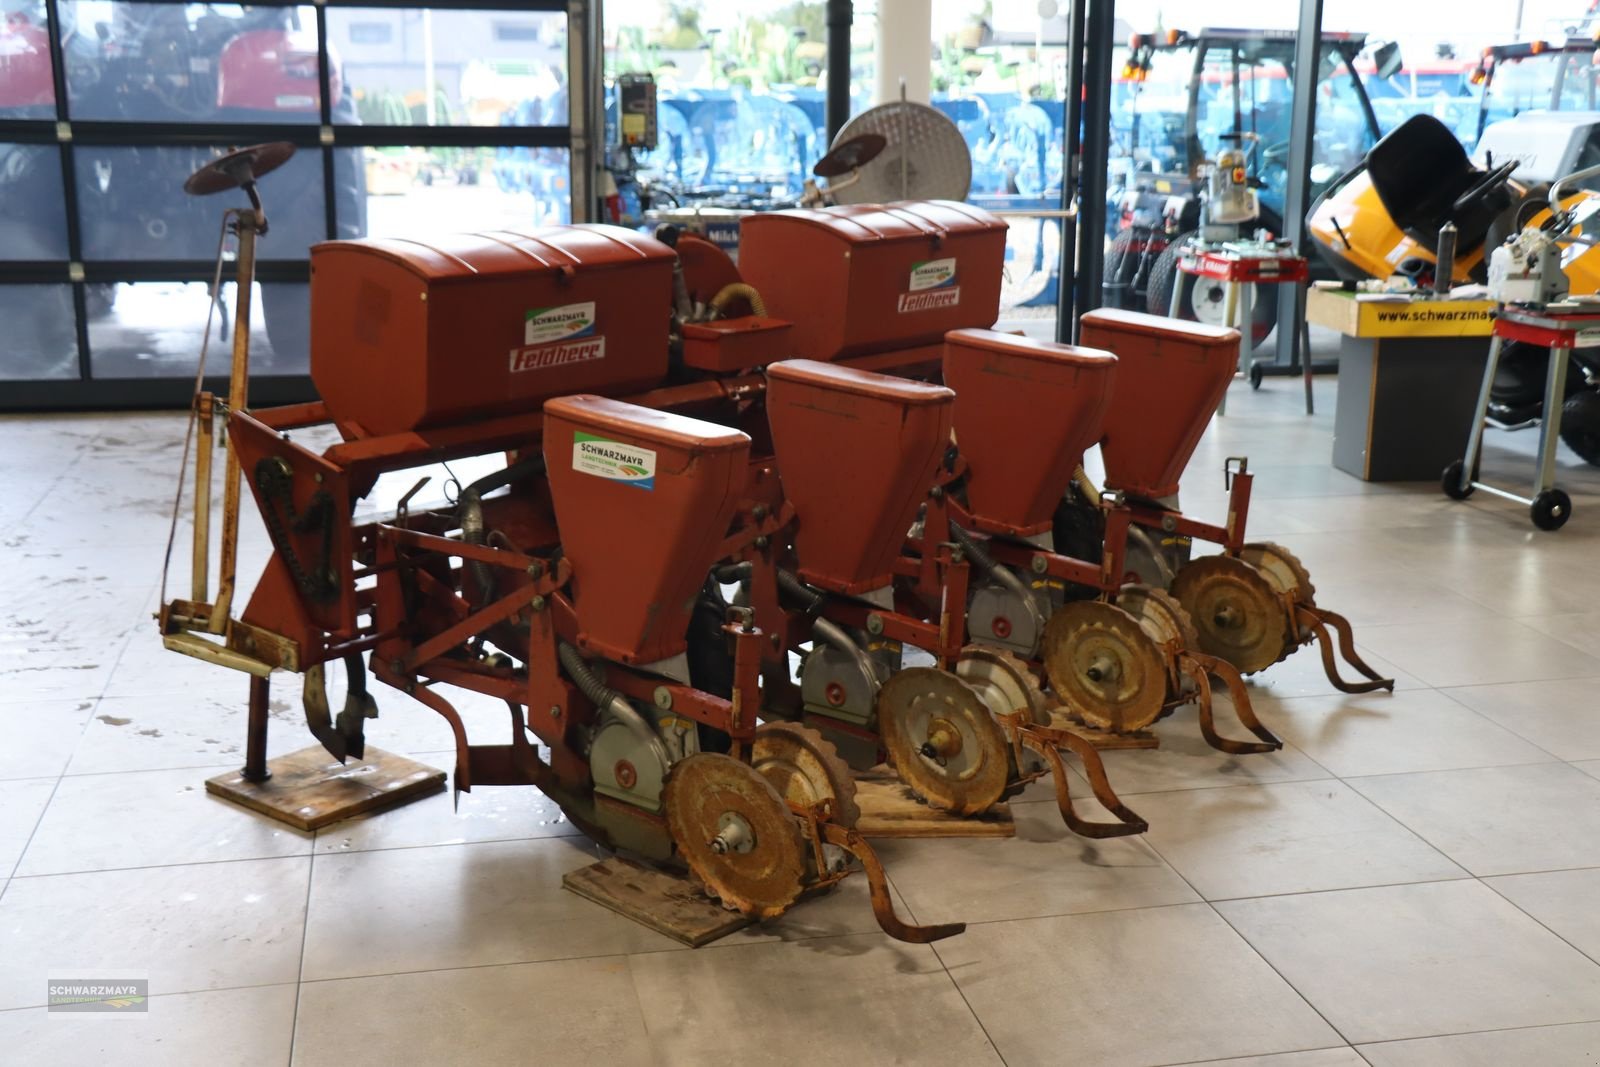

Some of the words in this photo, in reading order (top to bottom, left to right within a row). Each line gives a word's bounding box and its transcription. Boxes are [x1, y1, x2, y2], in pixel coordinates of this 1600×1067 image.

[532, 311, 586, 327] SCHWARZMAYR
[512, 342, 601, 371] Feldherr
[581, 442, 644, 466] SCHWARZMAYR
